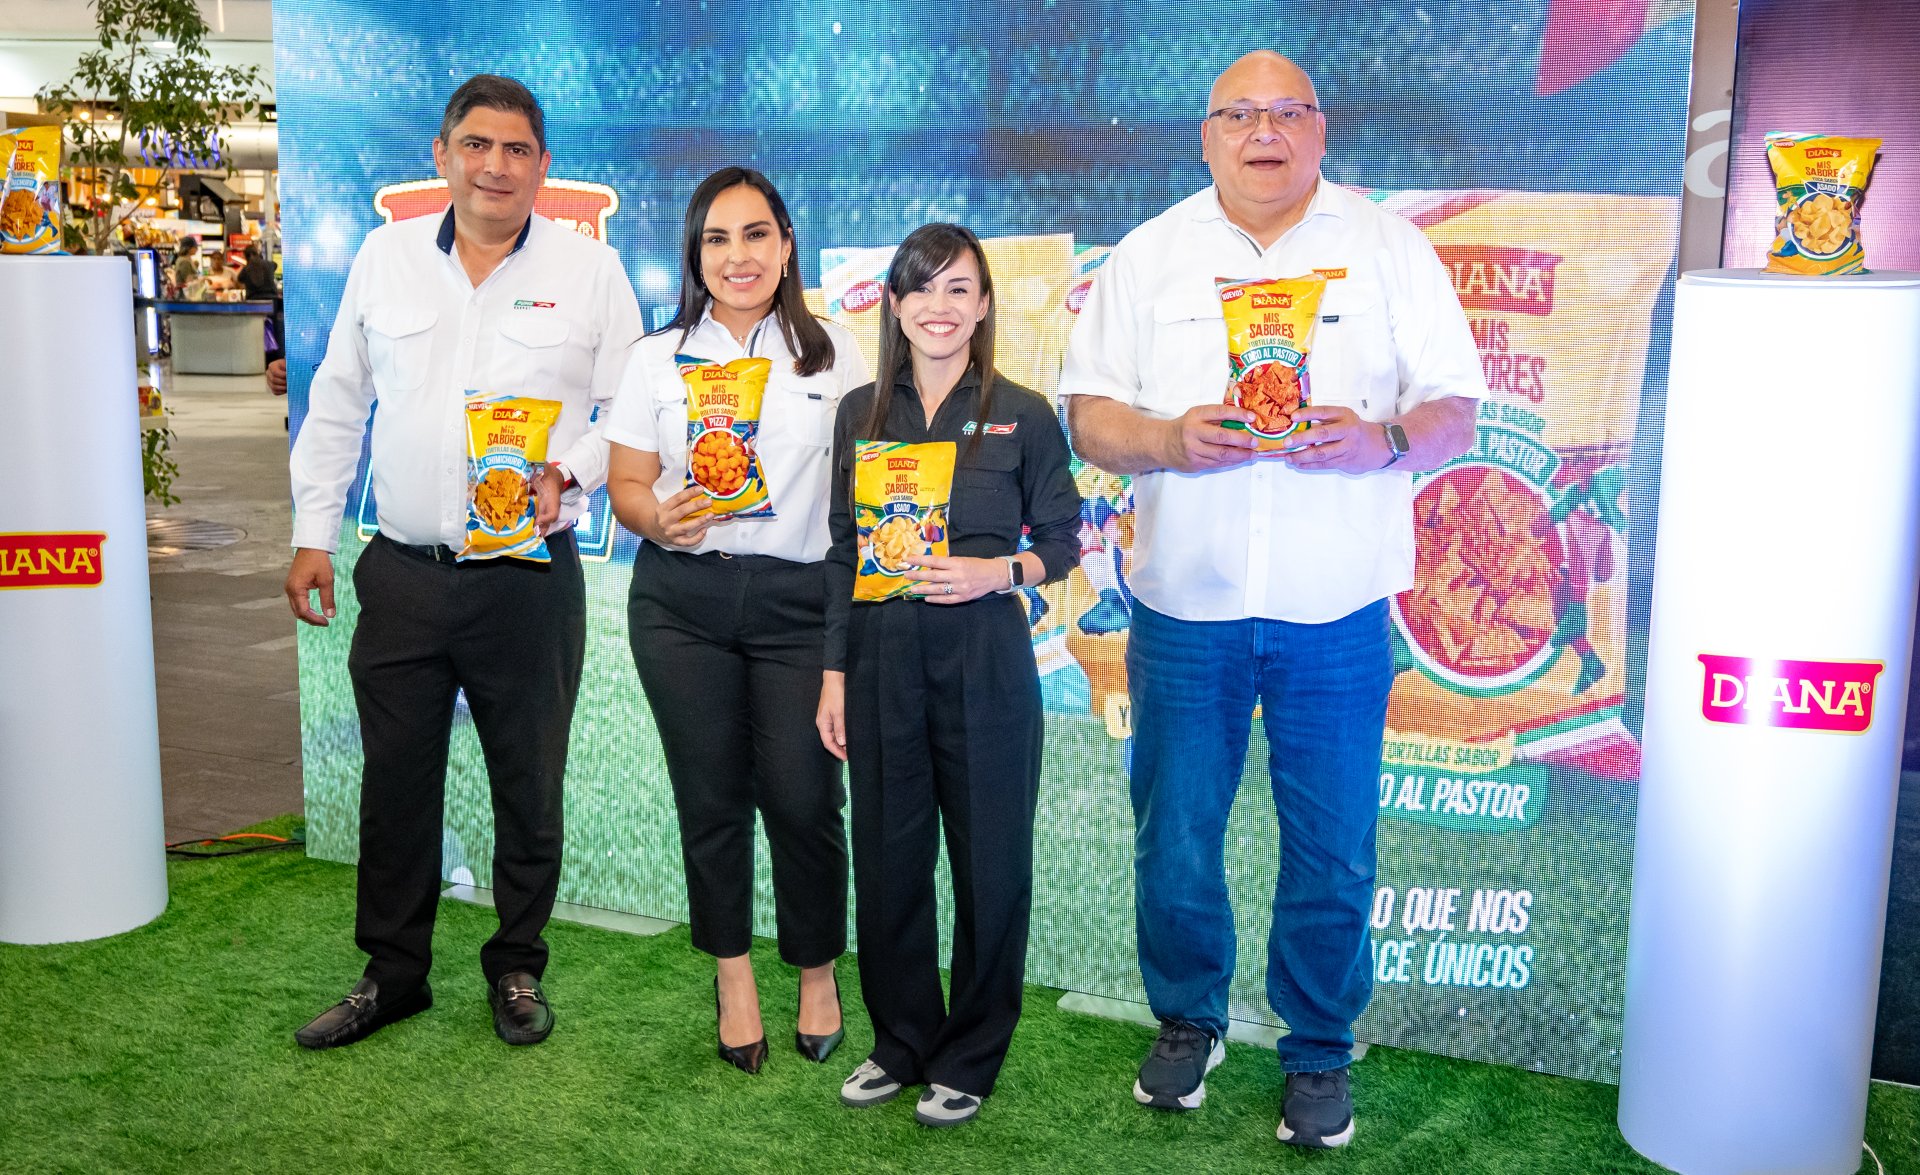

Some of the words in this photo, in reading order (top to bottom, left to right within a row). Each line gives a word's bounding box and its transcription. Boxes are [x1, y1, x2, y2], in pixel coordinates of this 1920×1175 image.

[1222, 289, 1243, 300] NUEVOS
[1253, 296, 1290, 306] DIANA
[1263, 313, 1280, 323] MIS
[1249, 323, 1295, 339] SABORES
[1248, 338, 1276, 348] TORTILLAS
[1277, 338, 1296, 348] SABOR
[1244, 349, 1262, 364] TACO
[1263, 348, 1272, 358] AL
[1272, 347, 1300, 365] PASTOR
[1481, 352, 1547, 404] ORES
[712, 384, 726, 394] MIS
[699, 394, 739, 408] SABORES
[721, 408, 738, 417] SABOR
[709, 416, 726, 427] PIZZA
[501, 424, 515, 434] MIS
[487, 433, 527, 449] SABORES
[1489, 431, 1546, 477] PASTOR
[889, 461, 917, 469] DIANA
[896, 474, 908, 483] MIS
[885, 483, 919, 496] SABORES
[893, 504, 910, 513] ASADO
[1384, 741, 1451, 763] TORTILLAS
[1453, 747, 1501, 766] SABOR
[1379, 773, 1395, 808] O
[1394, 775, 1426, 811] AL
[1431, 778, 1530, 821] PASTOR
[1370, 887, 1395, 930] O
[1401, 887, 1461, 935] QUE
[1467, 889, 1533, 934] NOS
[1424, 931, 1534, 989] ÚNICOS
